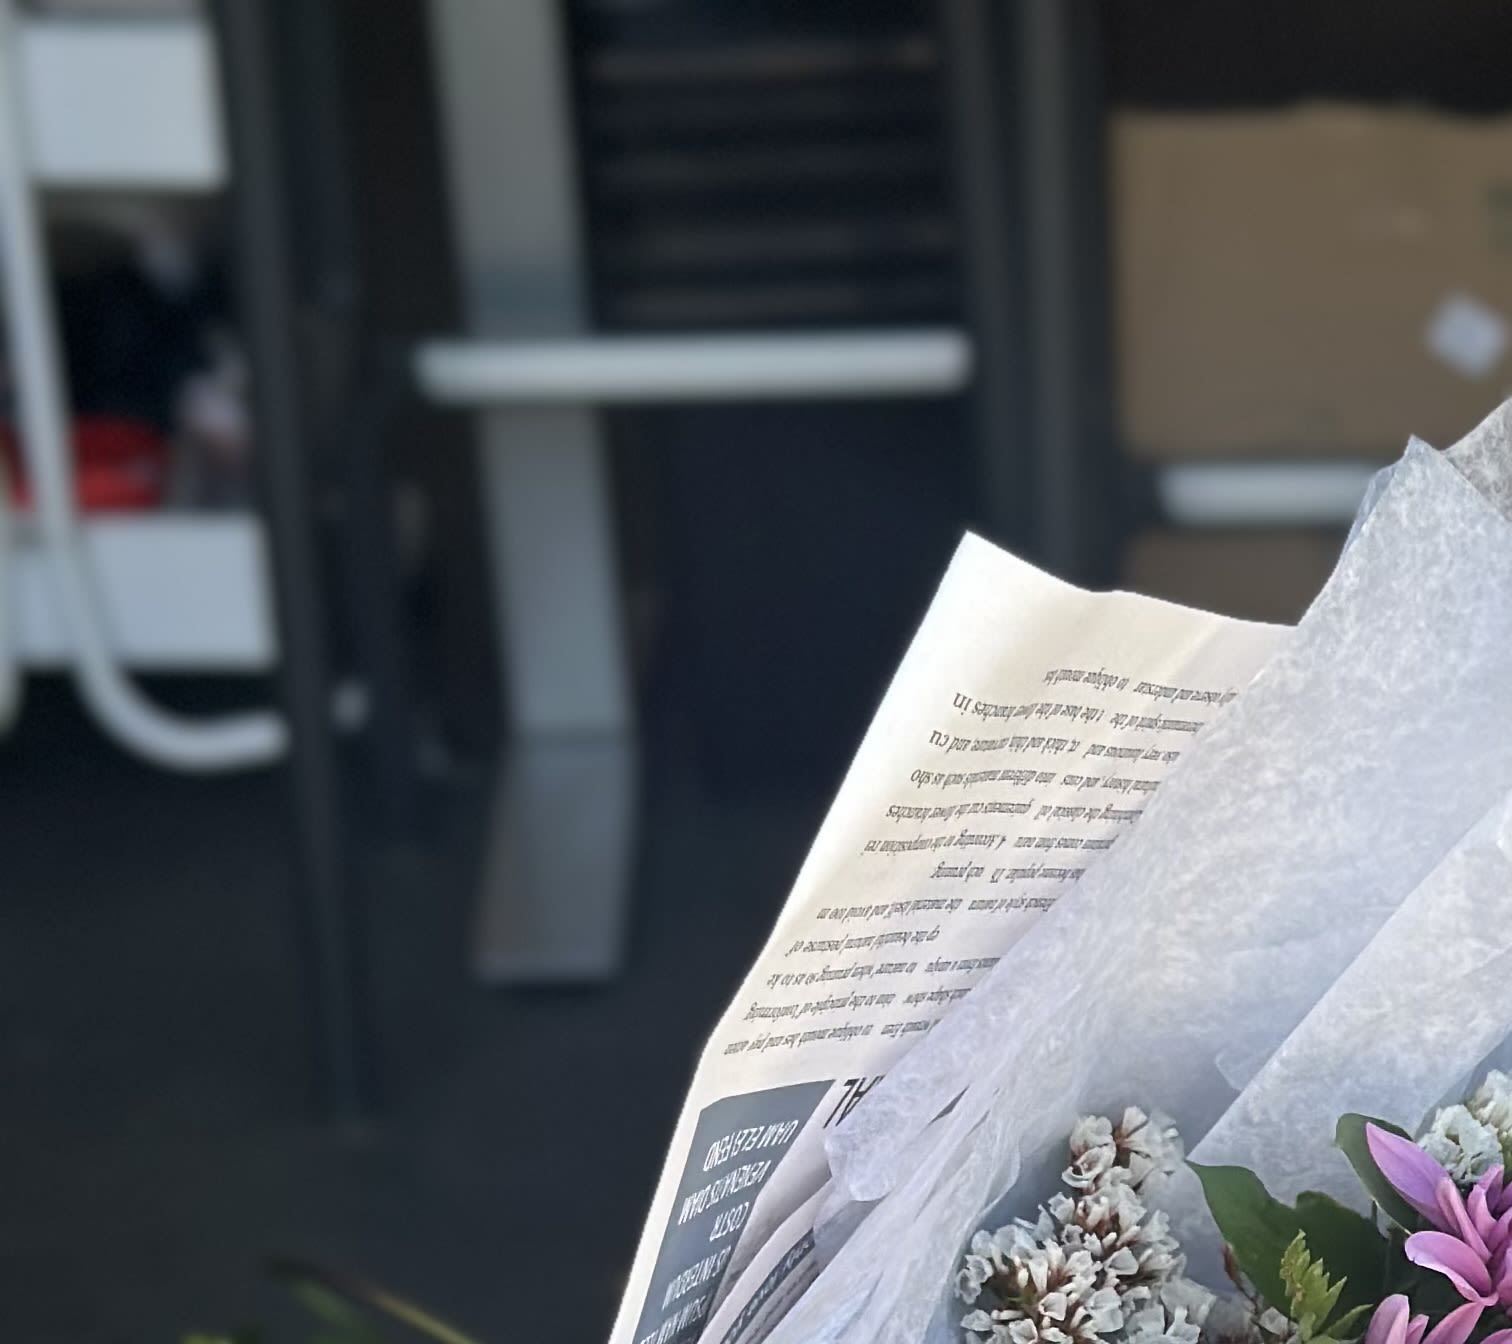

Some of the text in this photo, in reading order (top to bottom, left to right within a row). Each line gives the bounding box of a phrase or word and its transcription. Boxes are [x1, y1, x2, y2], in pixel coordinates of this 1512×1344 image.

[953, 693, 971, 715] in
[929, 730, 949, 746] cu
[910, 769, 933, 788] sho
[825, 1074, 885, 1128] AL
